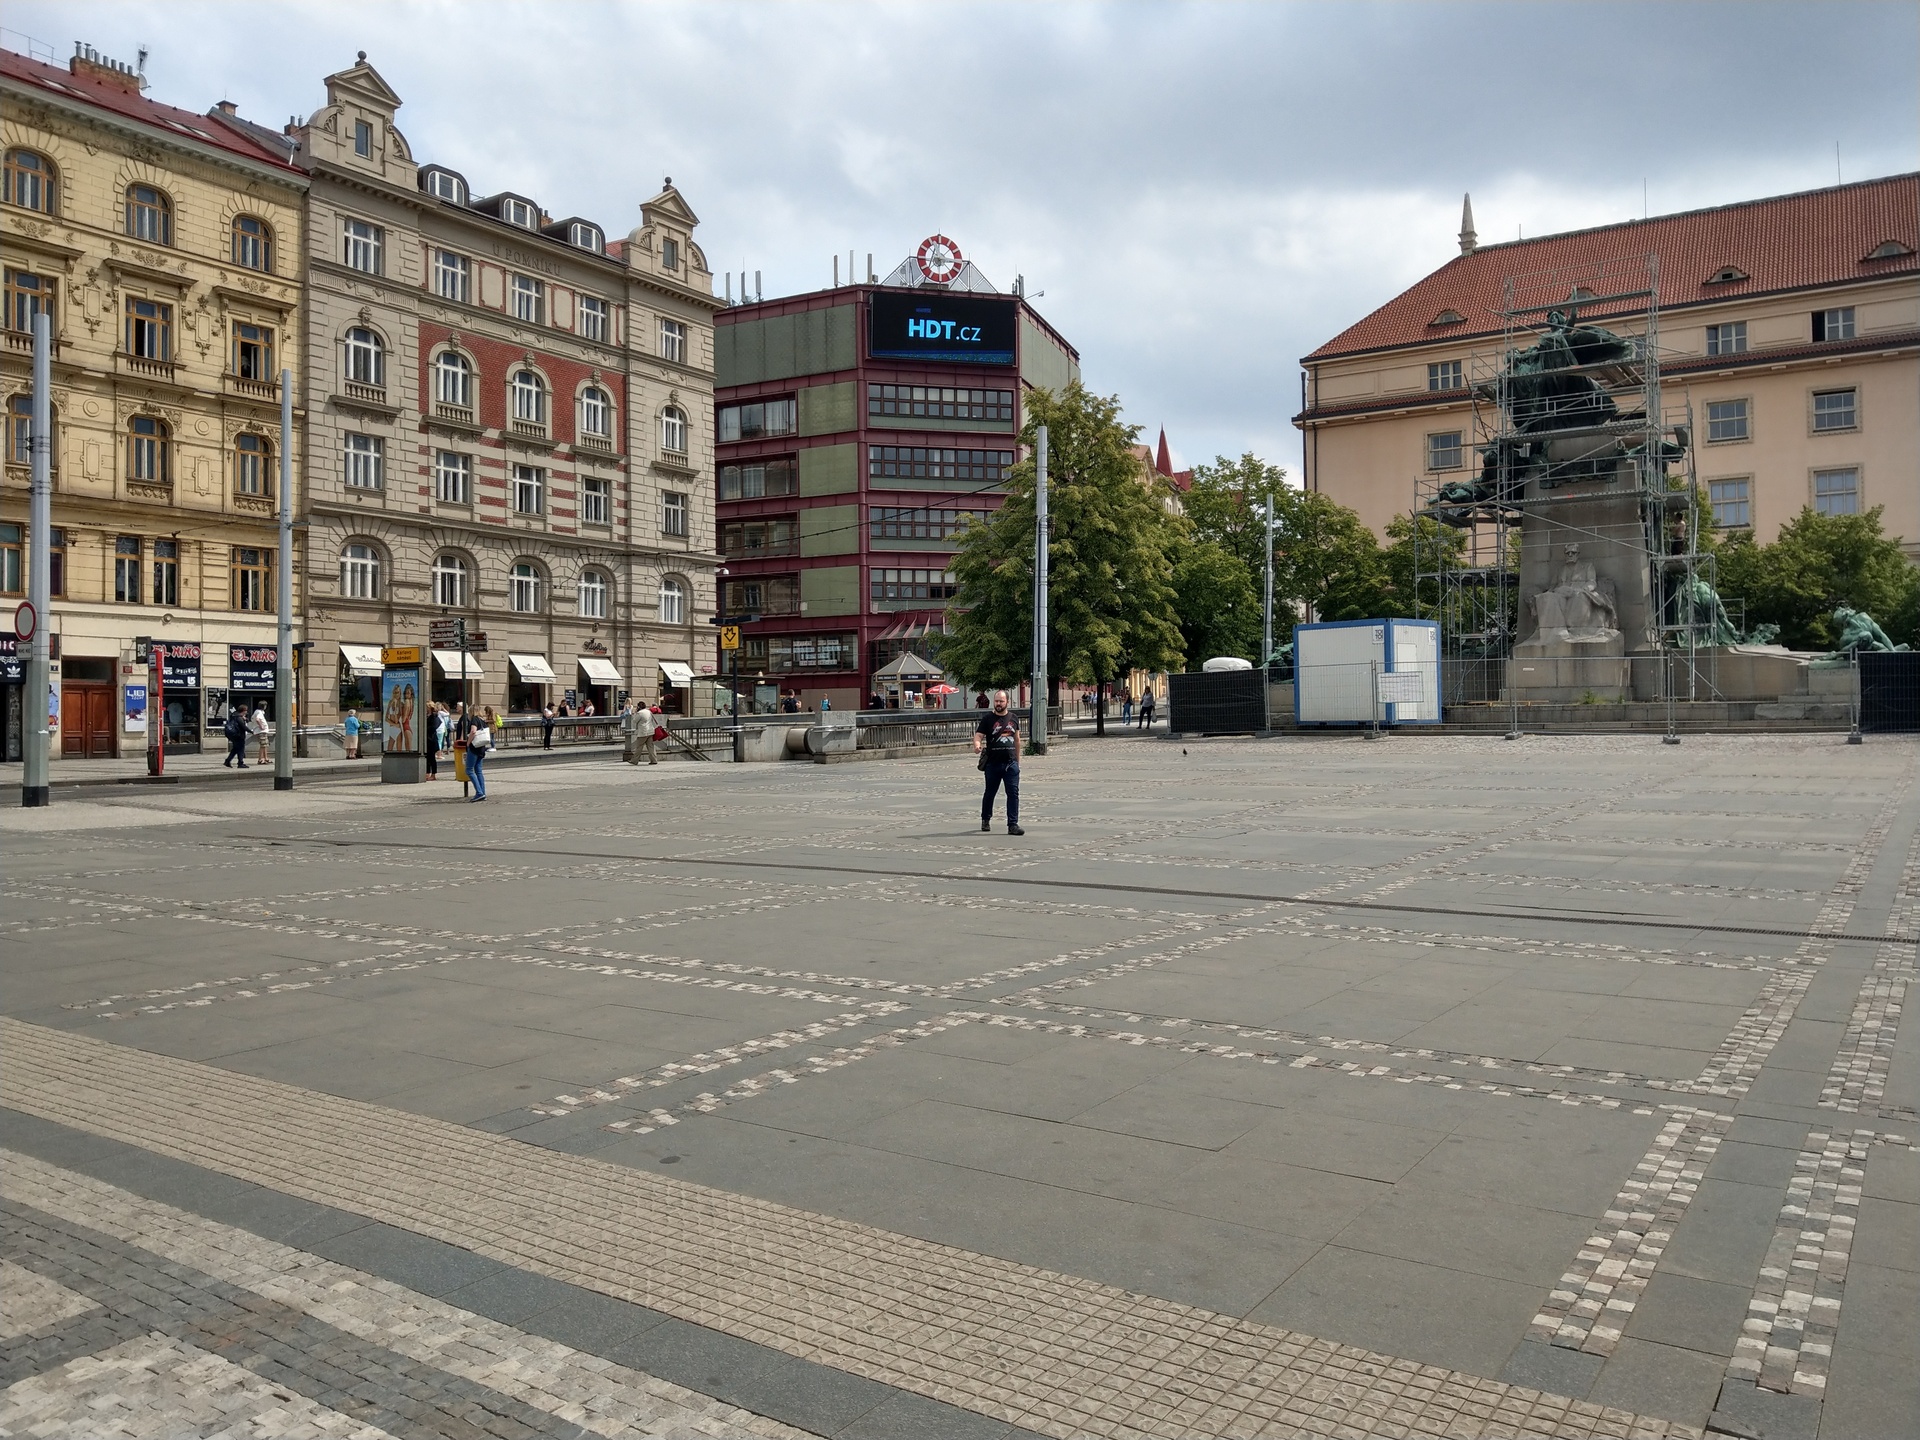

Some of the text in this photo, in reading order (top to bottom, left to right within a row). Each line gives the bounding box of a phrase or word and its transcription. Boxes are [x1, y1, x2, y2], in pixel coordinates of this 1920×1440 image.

[492, 244, 560, 275] U POMNÍKU
[231, 649, 249, 662] EL
